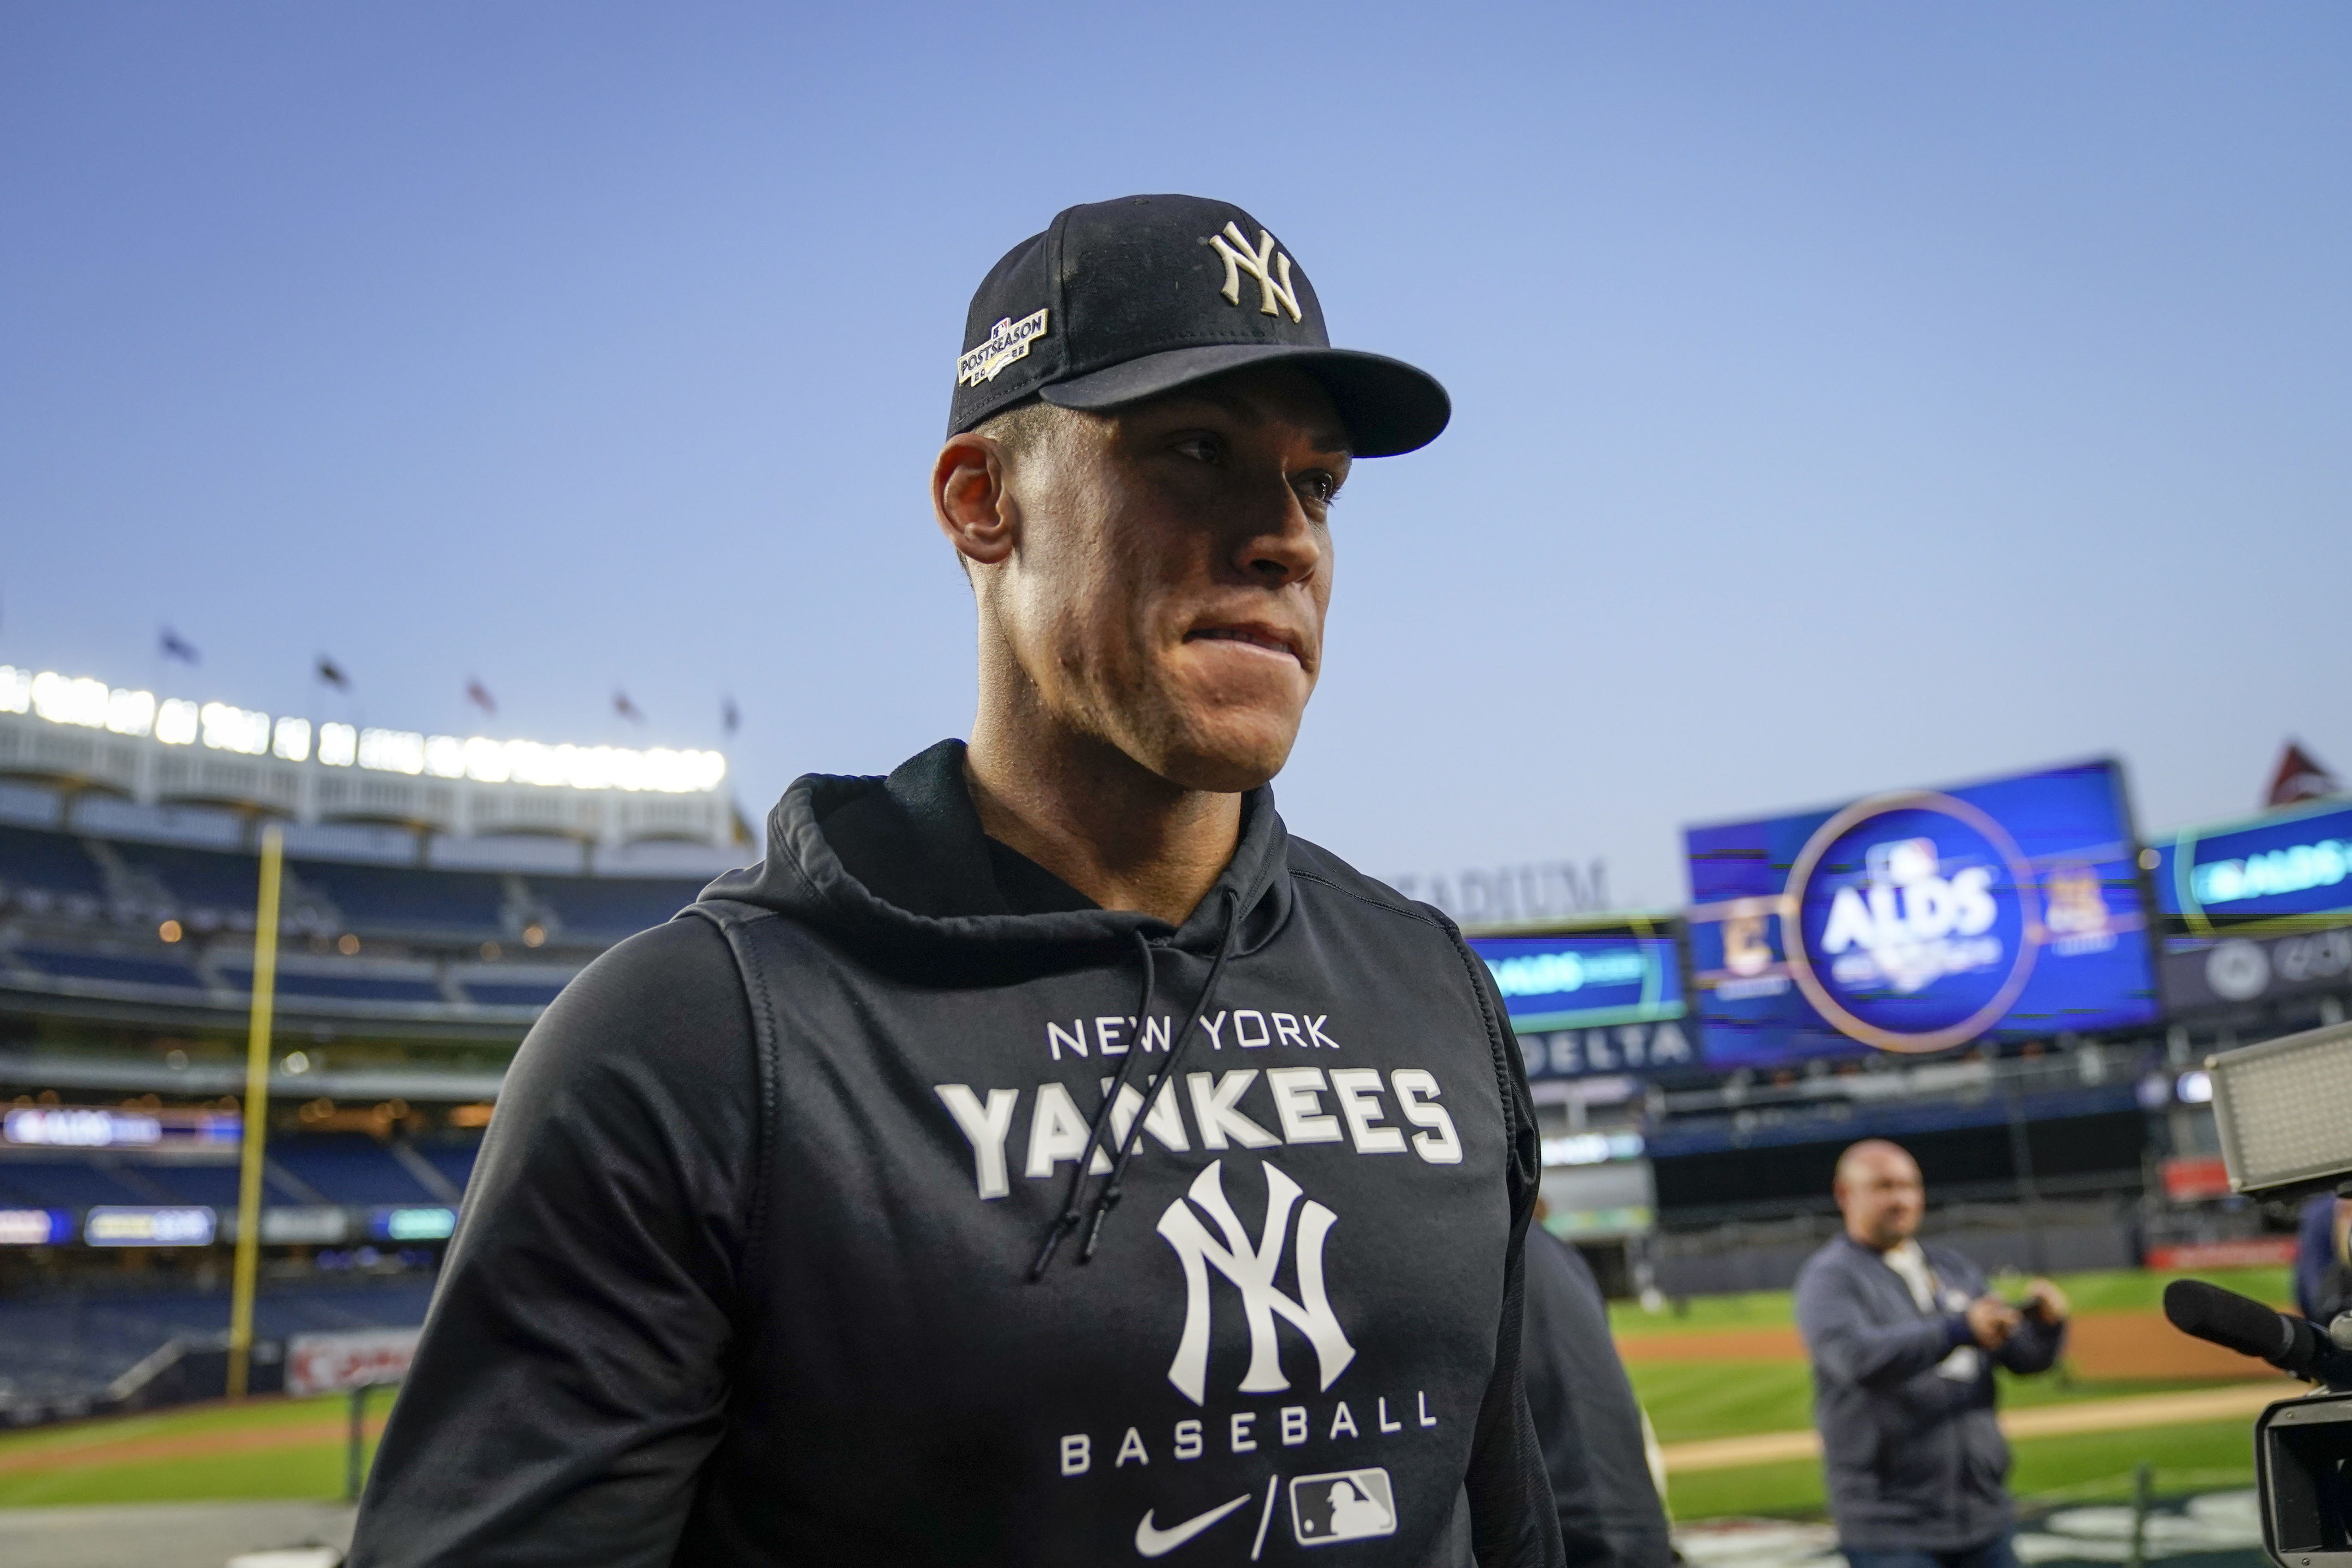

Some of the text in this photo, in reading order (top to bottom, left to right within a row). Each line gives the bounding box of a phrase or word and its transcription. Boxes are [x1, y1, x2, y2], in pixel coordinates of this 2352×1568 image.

[1209, 220, 1302, 324] NY
[961, 316, 1042, 377] POSTSEASON
[1821, 867, 1999, 955] ALDS
[1047, 1010, 1340, 1060] NEW YORK
[1516, 1022, 1693, 1077] DELTA
[935, 1066, 1463, 1200] YANKEES
[1156, 1159, 1356, 1408] NY
[1060, 1390, 1437, 1476] BASEBALL
